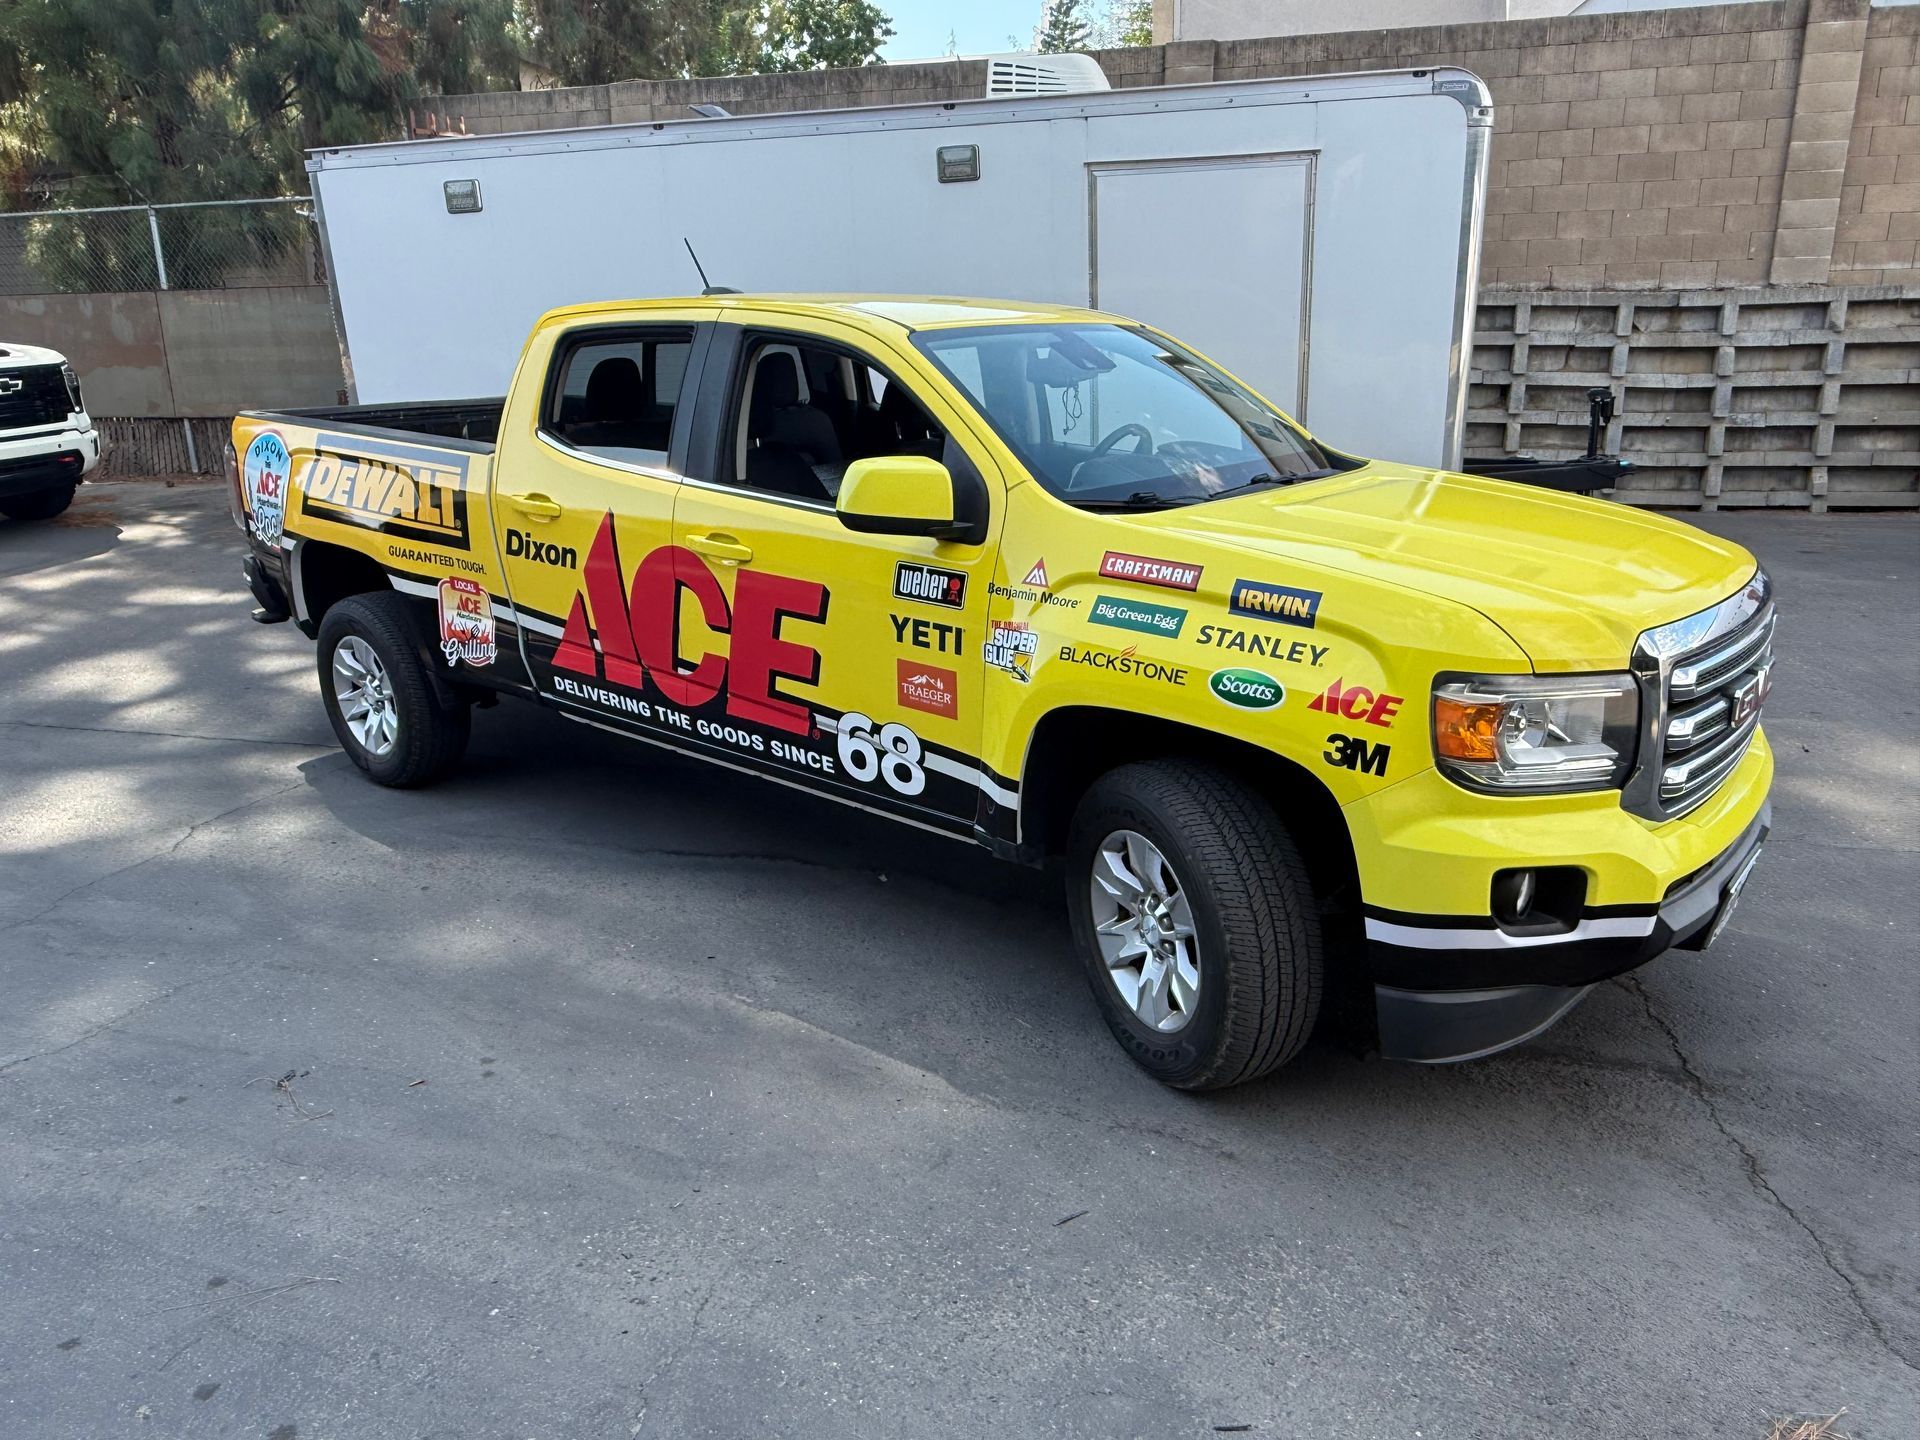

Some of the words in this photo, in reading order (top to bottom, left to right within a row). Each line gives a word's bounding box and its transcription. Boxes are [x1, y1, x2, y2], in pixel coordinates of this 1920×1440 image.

[254, 440, 283, 462] DIXON
[256, 467, 282, 499] ACE
[307, 451, 461, 529] DEWALT
[388, 545, 455, 567] GUARANTEED
[505, 529, 577, 570] Dixon
[454, 579, 477, 593] LOCAL
[899, 566, 948, 600] weber
[1105, 557, 1195, 585] CRAFTSMAN
[456, 594, 482, 616] ACE
[987, 582, 1037, 602] Benjamin
[1039, 591, 1079, 609] Moore
[1238, 588, 1311, 618] IRWIN
[551, 507, 831, 738] ACE
[1096, 603, 1118, 619] Big
[1117, 607, 1152, 623] Green
[1152, 613, 1180, 630] Egg
[889, 614, 963, 656] YETI
[993, 627, 1038, 654] SUPER
[1196, 624, 1330, 667] STANLEY
[440, 637, 498, 667] Grilling
[984, 643, 1014, 669] GLUE
[1059, 646, 1189, 686] BLACKSTONE
[901, 682, 951, 705] TRAEGER
[1217, 674, 1275, 701] Scotts
[1306, 676, 1405, 728] ACE
[553, 675, 651, 717] DELIVERING
[654, 705, 692, 731] THE
[696, 719, 765, 751] GOODS
[770, 740, 836, 774] SINCE
[837, 712, 926, 796] 68
[1322, 733, 1391, 778] 3M
